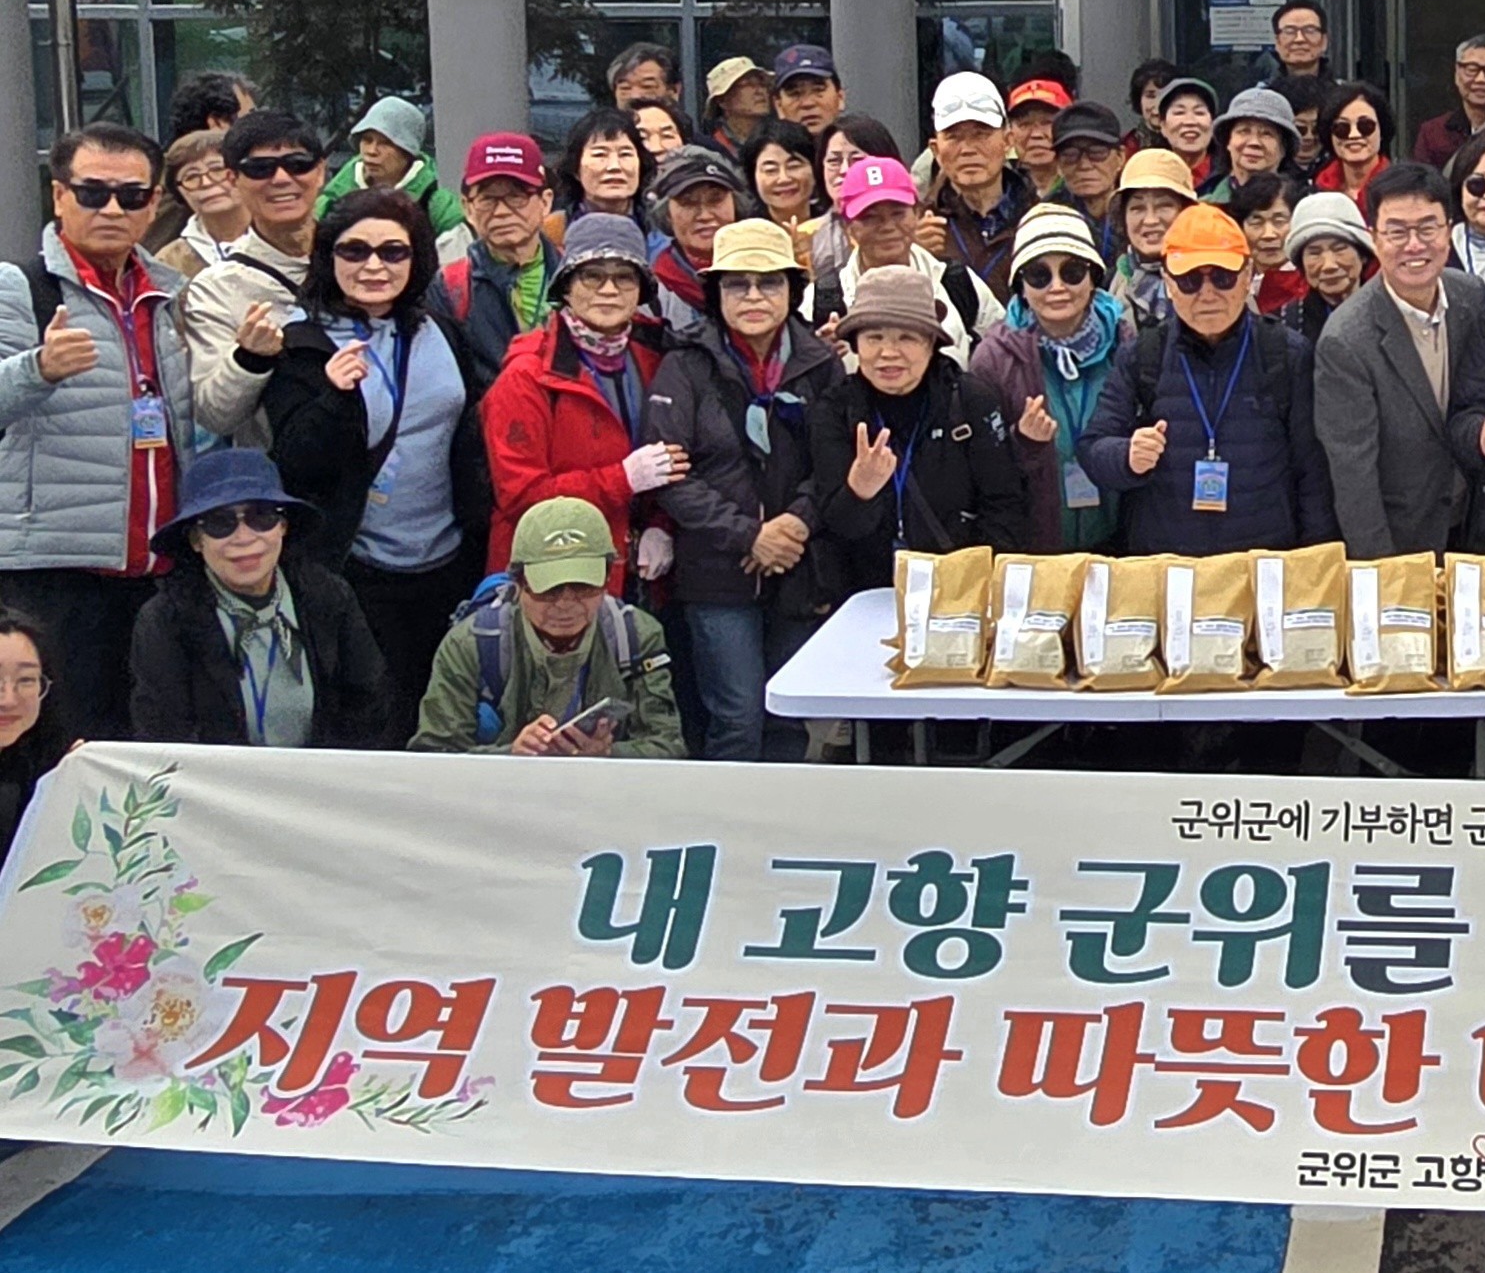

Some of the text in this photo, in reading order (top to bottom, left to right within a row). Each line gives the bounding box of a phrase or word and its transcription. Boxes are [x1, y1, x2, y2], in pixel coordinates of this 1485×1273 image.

[866, 166, 883, 185] B
[1171, 798, 1311, 842] 군위군에
[1321, 801, 1454, 845] 기부하면
[577, 845, 717, 970] 내
[743, 849, 1030, 980] 고향
[1059, 860, 1470, 994] 군위를
[184, 970, 497, 1099] 지역
[530, 985, 962, 1120] 발전과
[997, 1001, 1441, 1136] 따뜻한
[1298, 1151, 1401, 1189] 군위군
